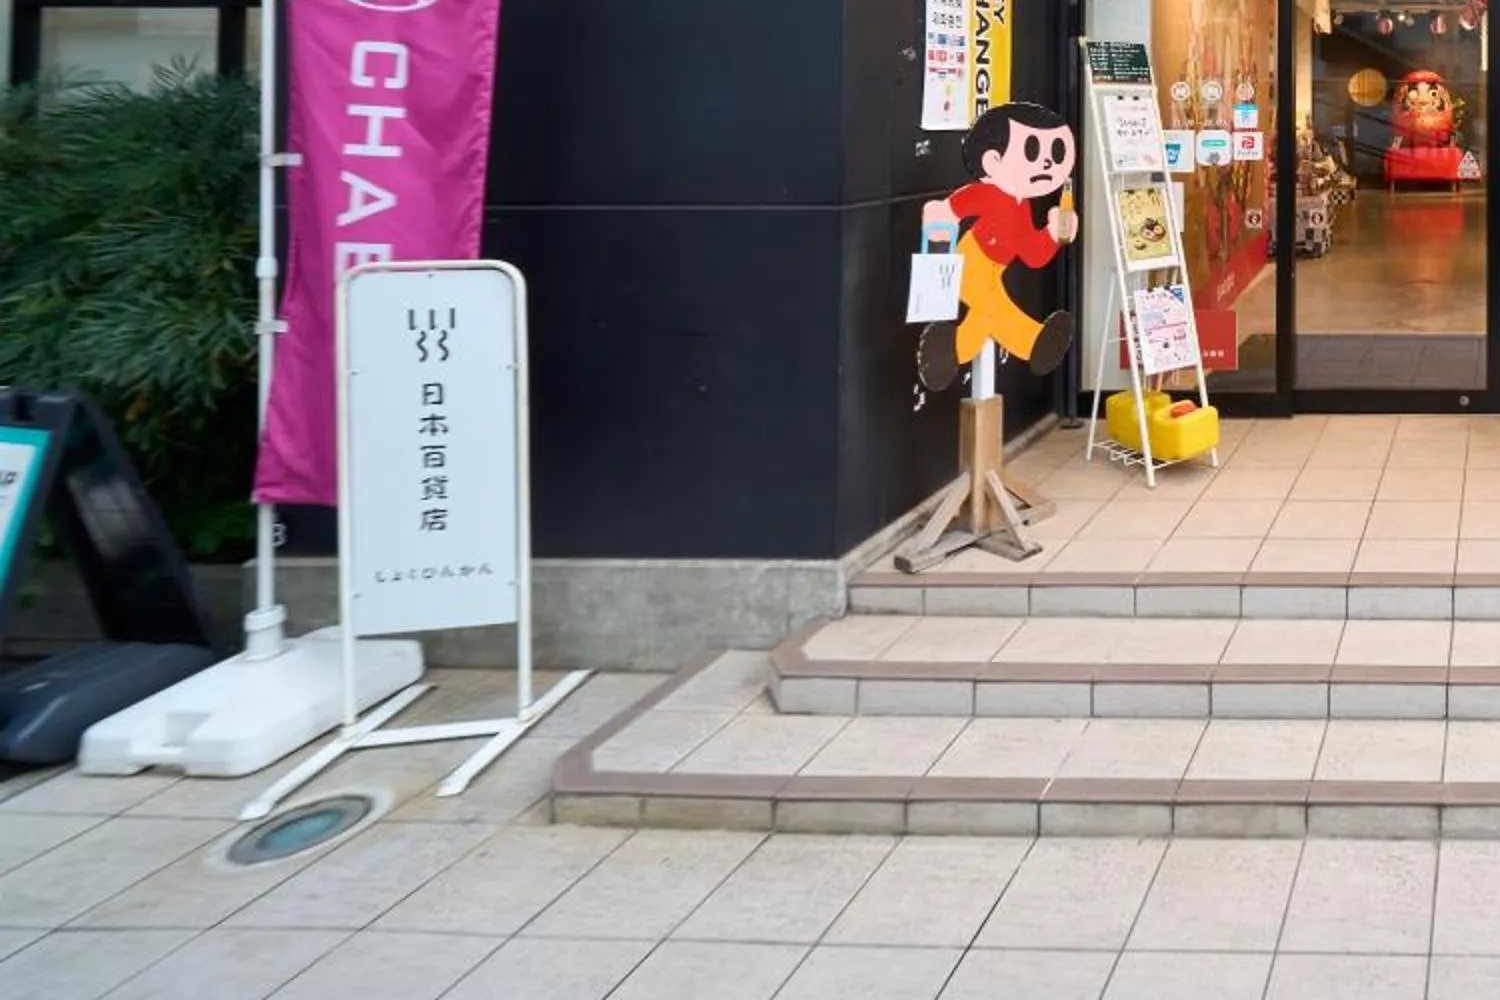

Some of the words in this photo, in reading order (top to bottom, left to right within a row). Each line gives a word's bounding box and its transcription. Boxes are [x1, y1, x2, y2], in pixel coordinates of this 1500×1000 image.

[417, 382, 449, 532] 日本百貨店
